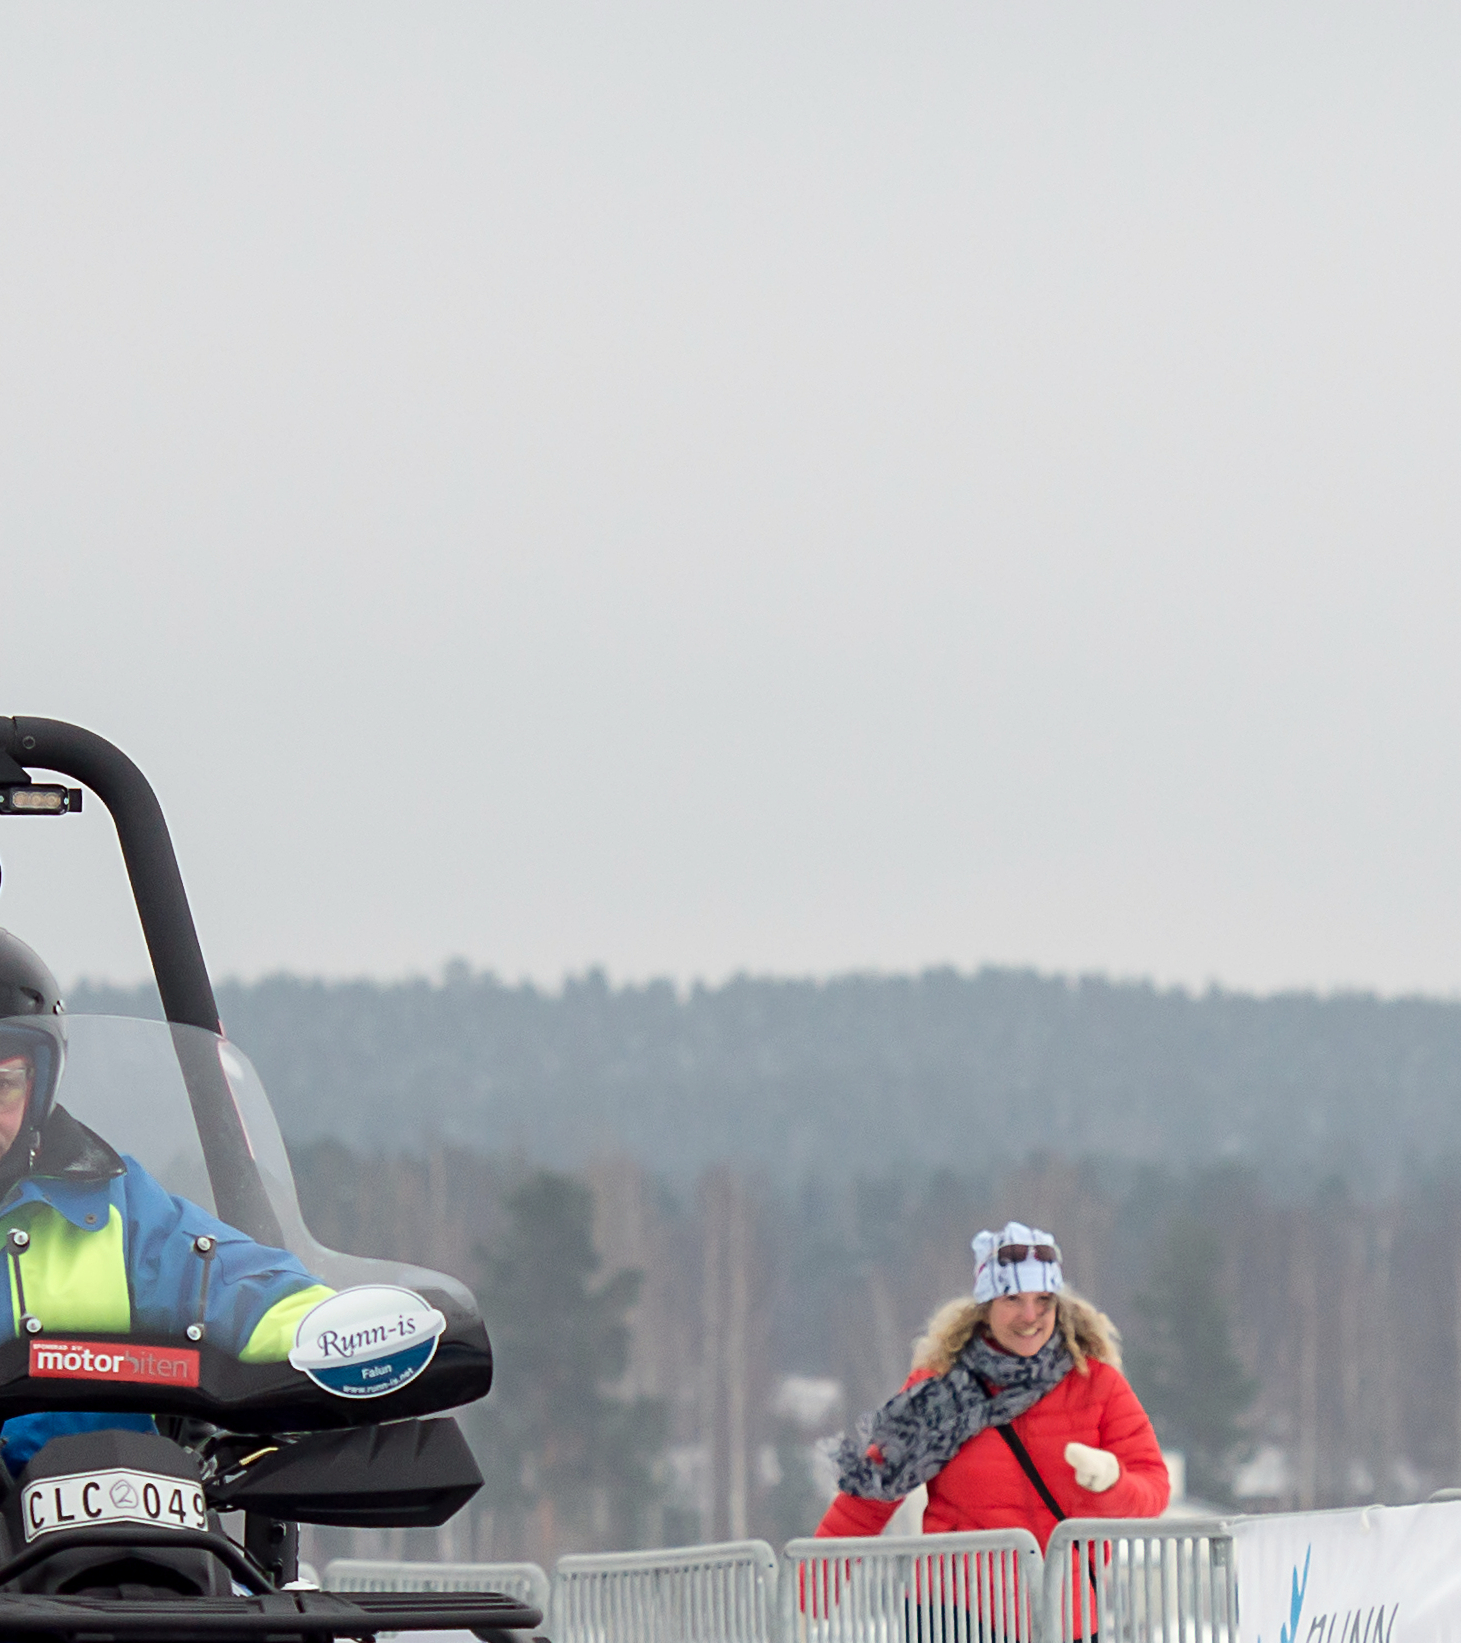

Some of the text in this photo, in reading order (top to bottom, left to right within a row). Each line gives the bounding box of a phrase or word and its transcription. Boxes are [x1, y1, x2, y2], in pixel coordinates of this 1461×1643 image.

[317, 1314, 416, 1358] Runn-is
[343, 1367, 415, 1394] www.runn-is.net
[361, 1364, 392, 1380] Falun
[30, 1482, 102, 1530] CLC
[143, 1483, 205, 1528] 049
